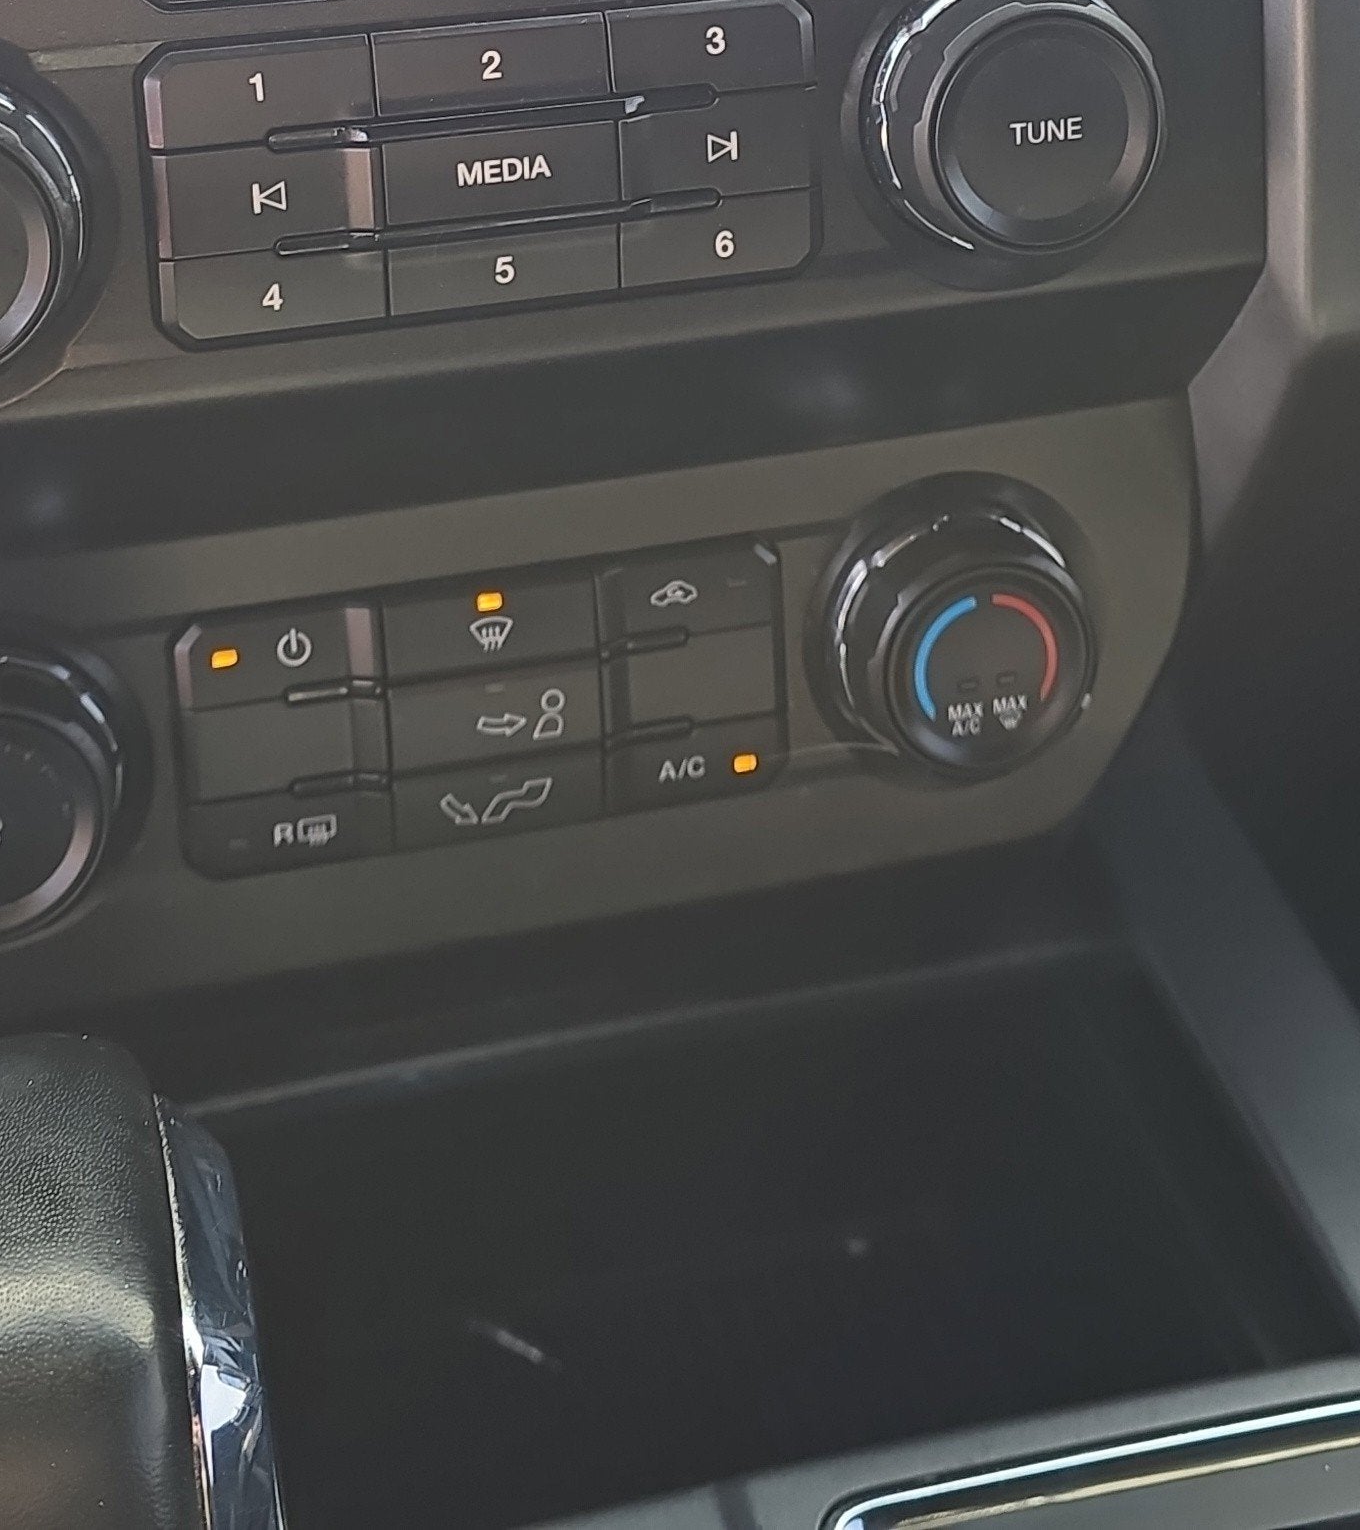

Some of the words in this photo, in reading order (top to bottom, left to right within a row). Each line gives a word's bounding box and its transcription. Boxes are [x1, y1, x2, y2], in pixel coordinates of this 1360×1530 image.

[705, 26, 727, 56] 3
[481, 50, 502, 79] 2
[249, 73, 265, 102] 1
[1009, 117, 1083, 146] TUNE
[457, 155, 552, 188] MEDIA
[714, 230, 735, 258] 6
[494, 256, 515, 284] 5
[262, 284, 284, 311] 4
[947, 702, 984, 721] MAX
[992, 695, 1027, 716] MAX
[951, 718, 981, 736] A/C
[658, 756, 705, 782] A/C
